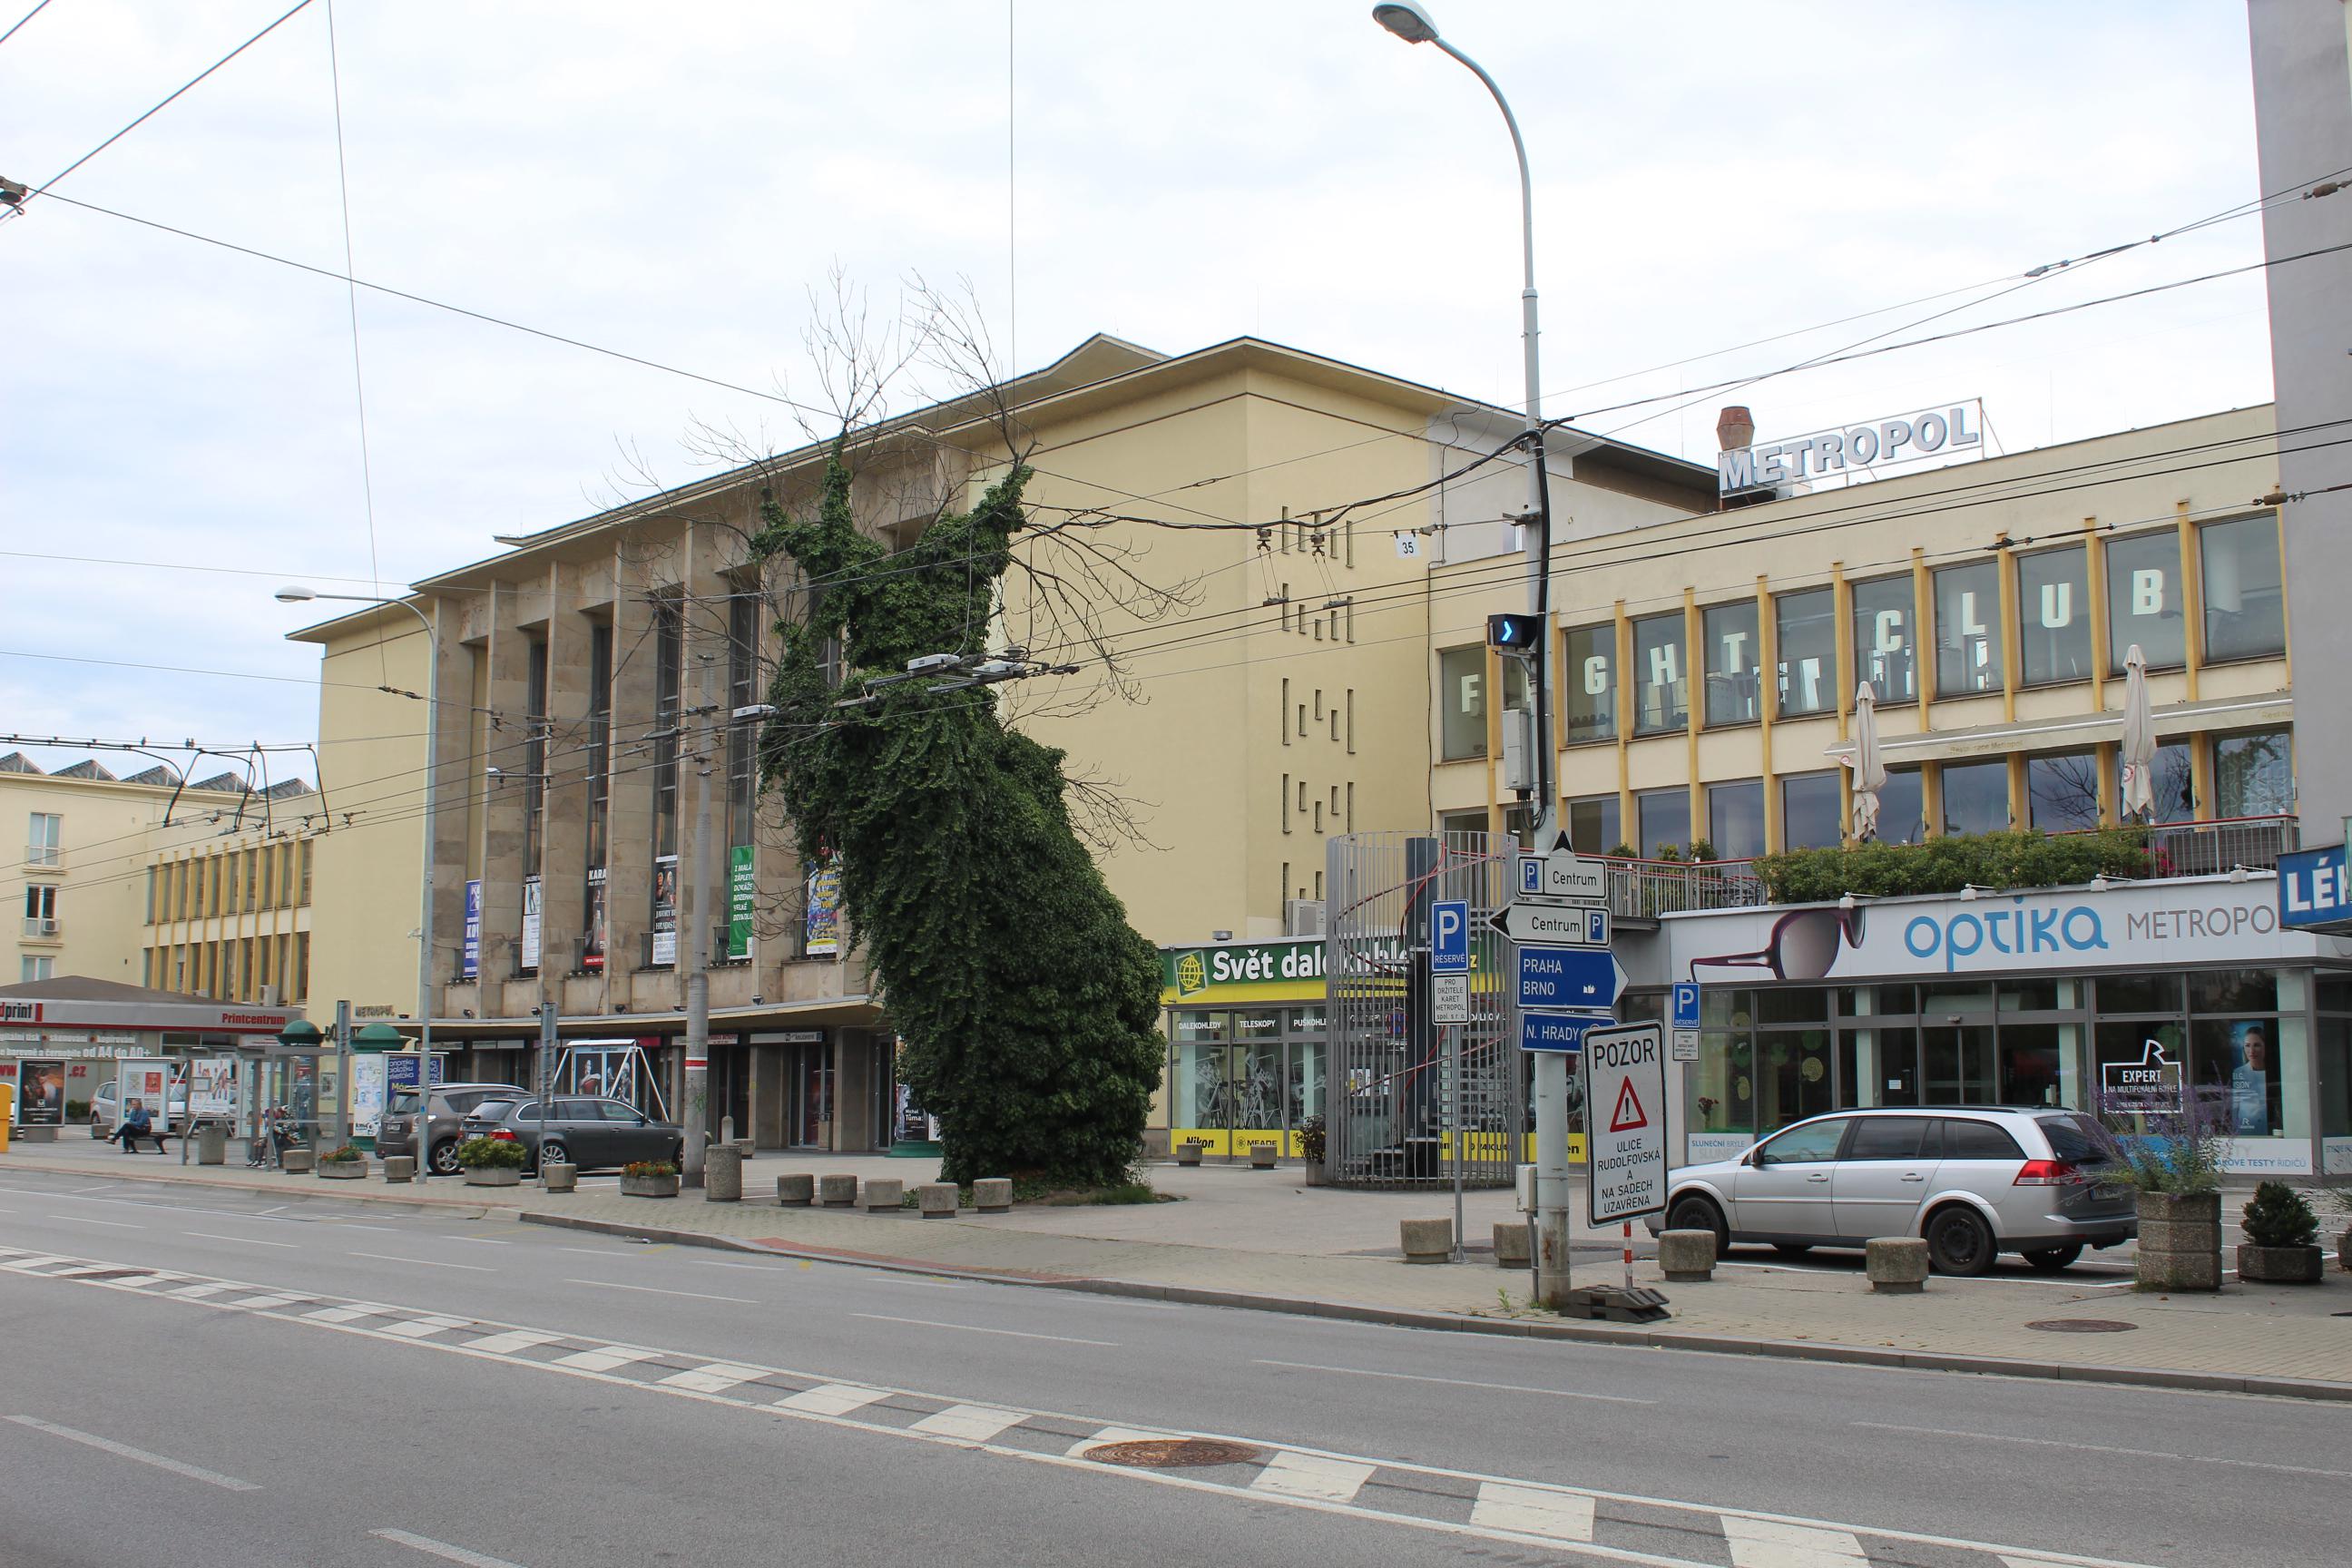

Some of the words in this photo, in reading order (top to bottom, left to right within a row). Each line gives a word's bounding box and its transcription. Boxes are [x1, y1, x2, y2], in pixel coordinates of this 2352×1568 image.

[1720, 408, 1979, 491] METROPOL
[1403, 542, 1414, 554] 35
[1876, 569, 2165, 653] CLUB
[1553, 871, 1597, 886] Centrum
[1439, 910, 1460, 950] P
[1532, 916, 1580, 933] Centrum
[1904, 895, 2109, 973] optika
[2127, 905, 2288, 941] METROPO
[1212, 949, 1274, 981] Svět
[1524, 959, 1563, 974] PRAHA
[1445, 978, 1456, 986] PRO
[1524, 982, 1555, 995] BRNO
[1437, 986, 1464, 995] DRŽITELE
[1679, 988, 1694, 1014] P
[222, 1013, 286, 1025] Printcentrum
[1179, 1021, 1221, 1030] DALEKOHLEDY
[1240, 1019, 1276, 1028] TELESKOPY
[1526, 1025, 1537, 1039] N.
[1543, 1026, 1579, 1041] HRADY
[83, 1048, 96, 1058] od
[98, 1046, 113, 1058] A4
[115, 1047, 128, 1058] do
[1594, 1038, 1655, 1069] POZOR
[2122, 1070, 2161, 1083] EXPERT
[2108, 1085, 2116, 1093] NA
[1186, 1136, 1214, 1149] Nikon
[1617, 1138, 1642, 1153] ULICE
[1691, 1139, 1725, 1147] SLUNEČNÍ
[1726, 1139, 1745, 1148] BRÝLE
[1598, 1146, 1661, 1171] RUDOLFOVSKÁ
[2248, 1159, 2274, 1168] TESTY
[1626, 1170, 1633, 1181] A
[1602, 1188, 1615, 1200] NA
[1618, 1180, 1652, 1196] SADECH
[1603, 1195, 1651, 1214] UZAVŘENA
